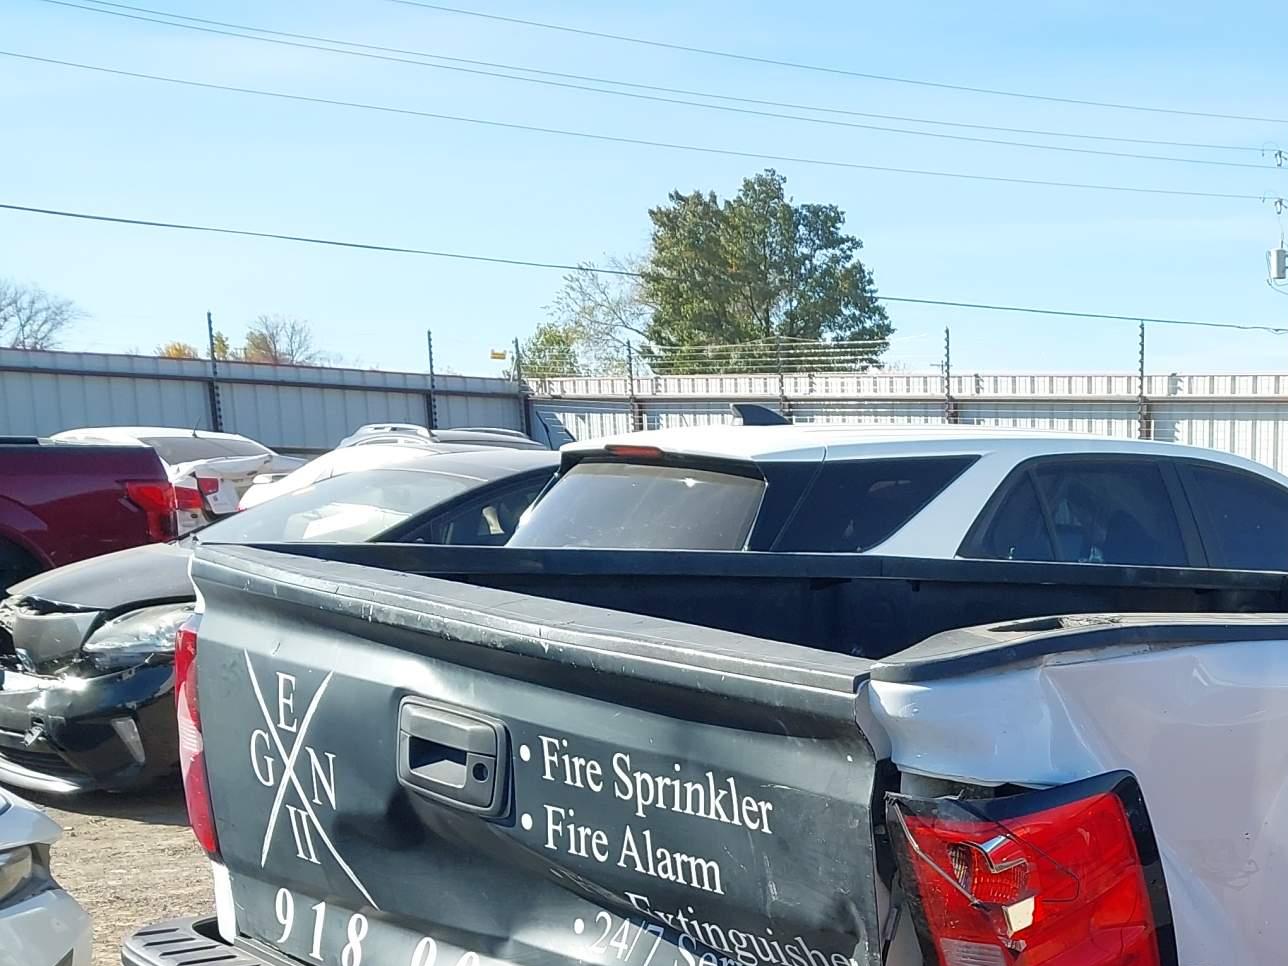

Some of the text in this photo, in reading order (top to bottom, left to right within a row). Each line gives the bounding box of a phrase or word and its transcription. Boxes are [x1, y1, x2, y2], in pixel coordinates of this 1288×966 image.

[276, 671, 297, 733] E
[250, 728, 337, 810] G N
[539, 735, 773, 834] Fire Sprinkler
[544, 805, 726, 896] Fire Alarm
